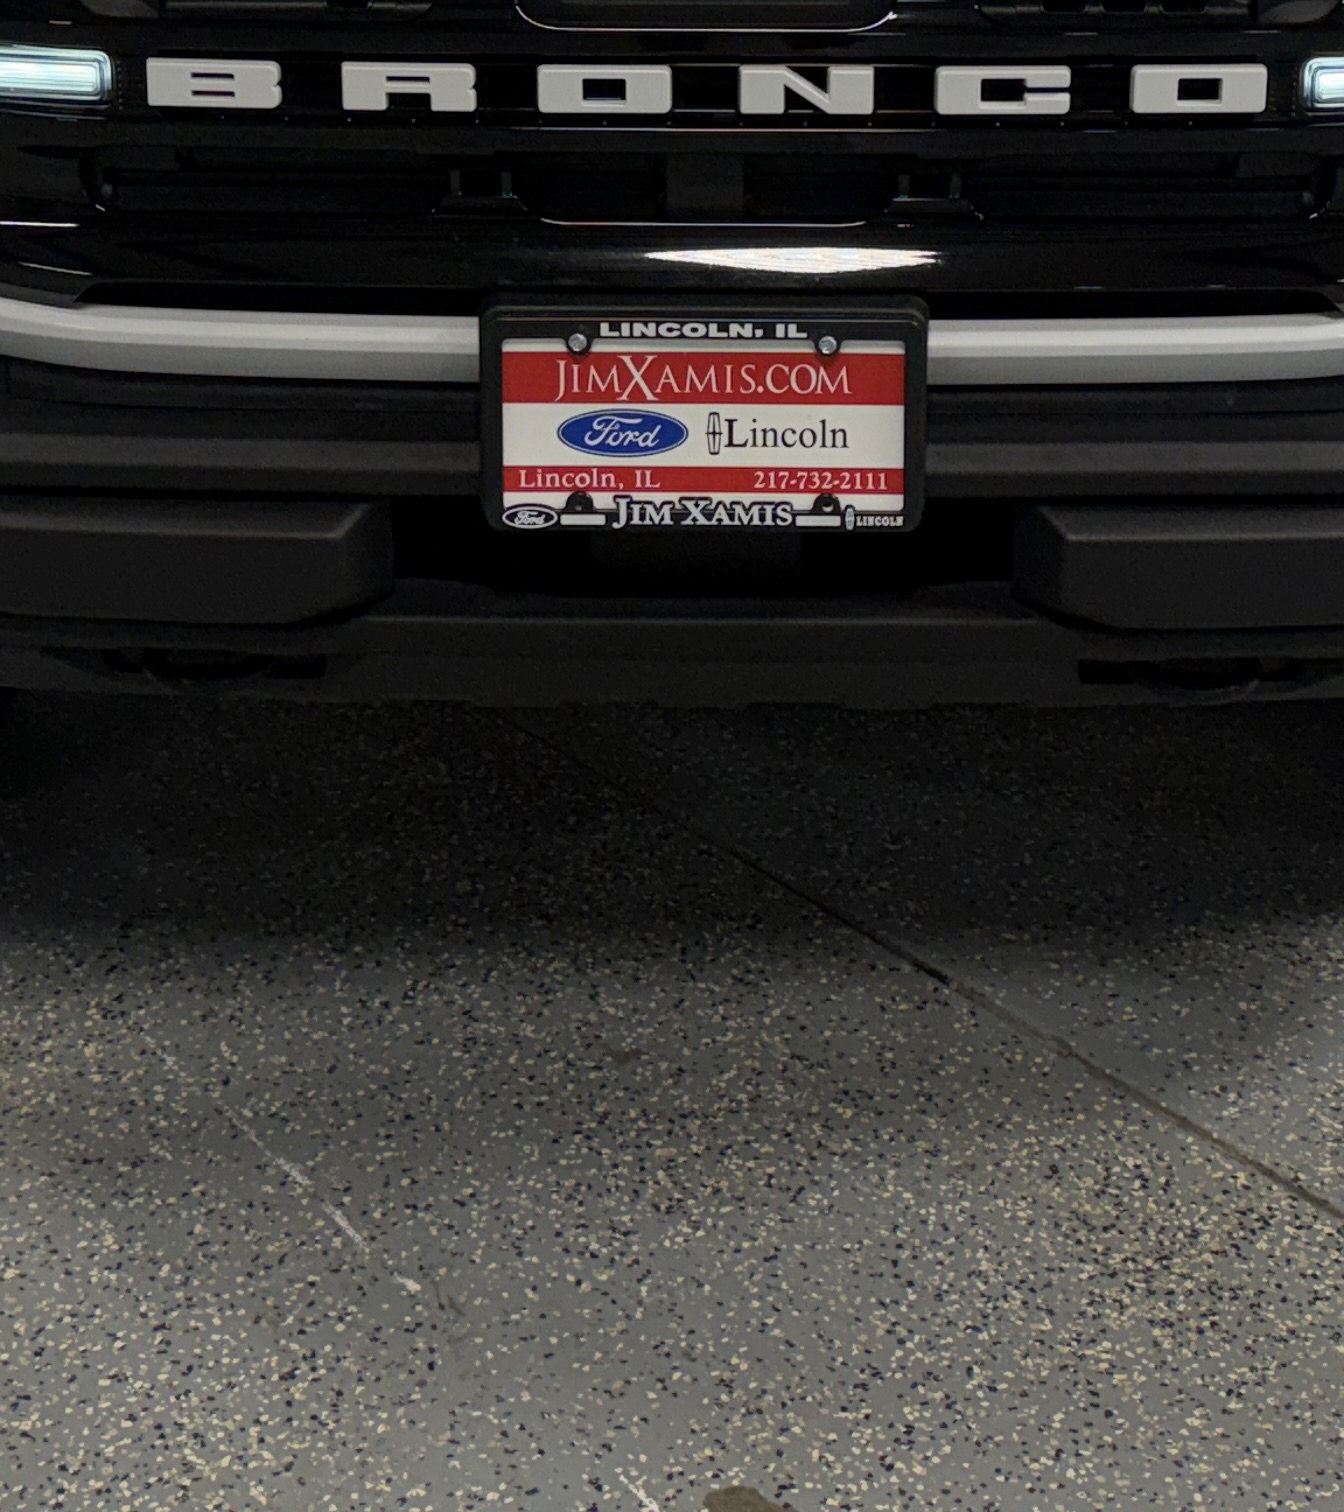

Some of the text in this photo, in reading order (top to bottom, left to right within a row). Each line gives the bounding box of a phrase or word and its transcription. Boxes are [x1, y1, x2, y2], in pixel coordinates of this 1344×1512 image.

[146, 57, 1269, 116] BRONCO
[599, 322, 808, 339] LINCOLN, IL
[554, 354, 853, 402] JIMXAMIS.COM
[583, 416, 849, 449] Ford Lincoln
[519, 469, 888, 490] Lincoln, IL 217-732-2111
[514, 510, 546, 526] Ford
[612, 496, 793, 528] JIM XAMIS
[856, 516, 904, 527] LINCOLN
